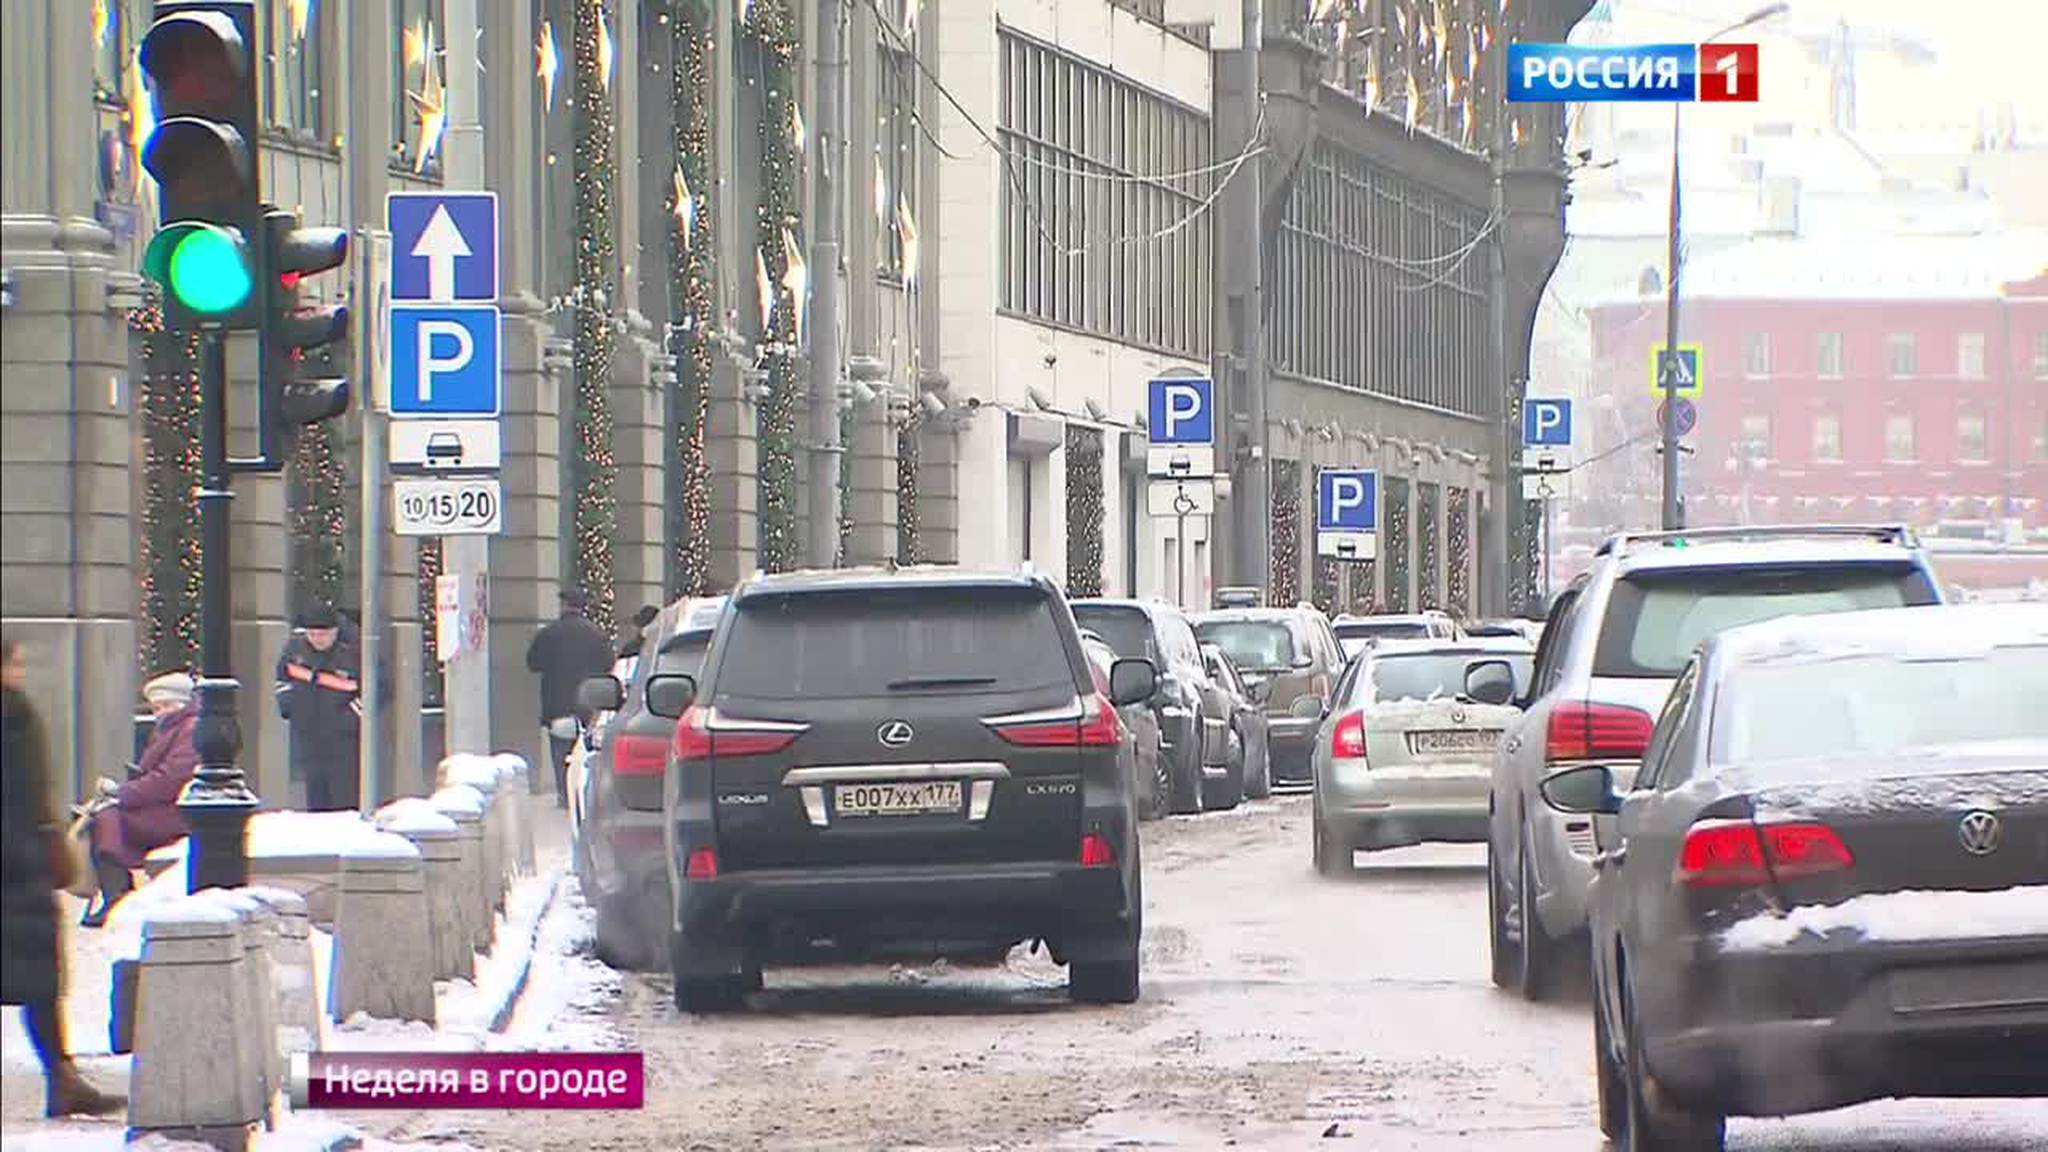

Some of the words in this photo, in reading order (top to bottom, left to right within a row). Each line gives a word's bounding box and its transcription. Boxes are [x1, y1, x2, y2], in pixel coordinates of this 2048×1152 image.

[418, 320, 474, 401] P
[1165, 385, 1201, 438] P
[1536, 404, 1561, 440] P
[1332, 477, 1364, 524] P
